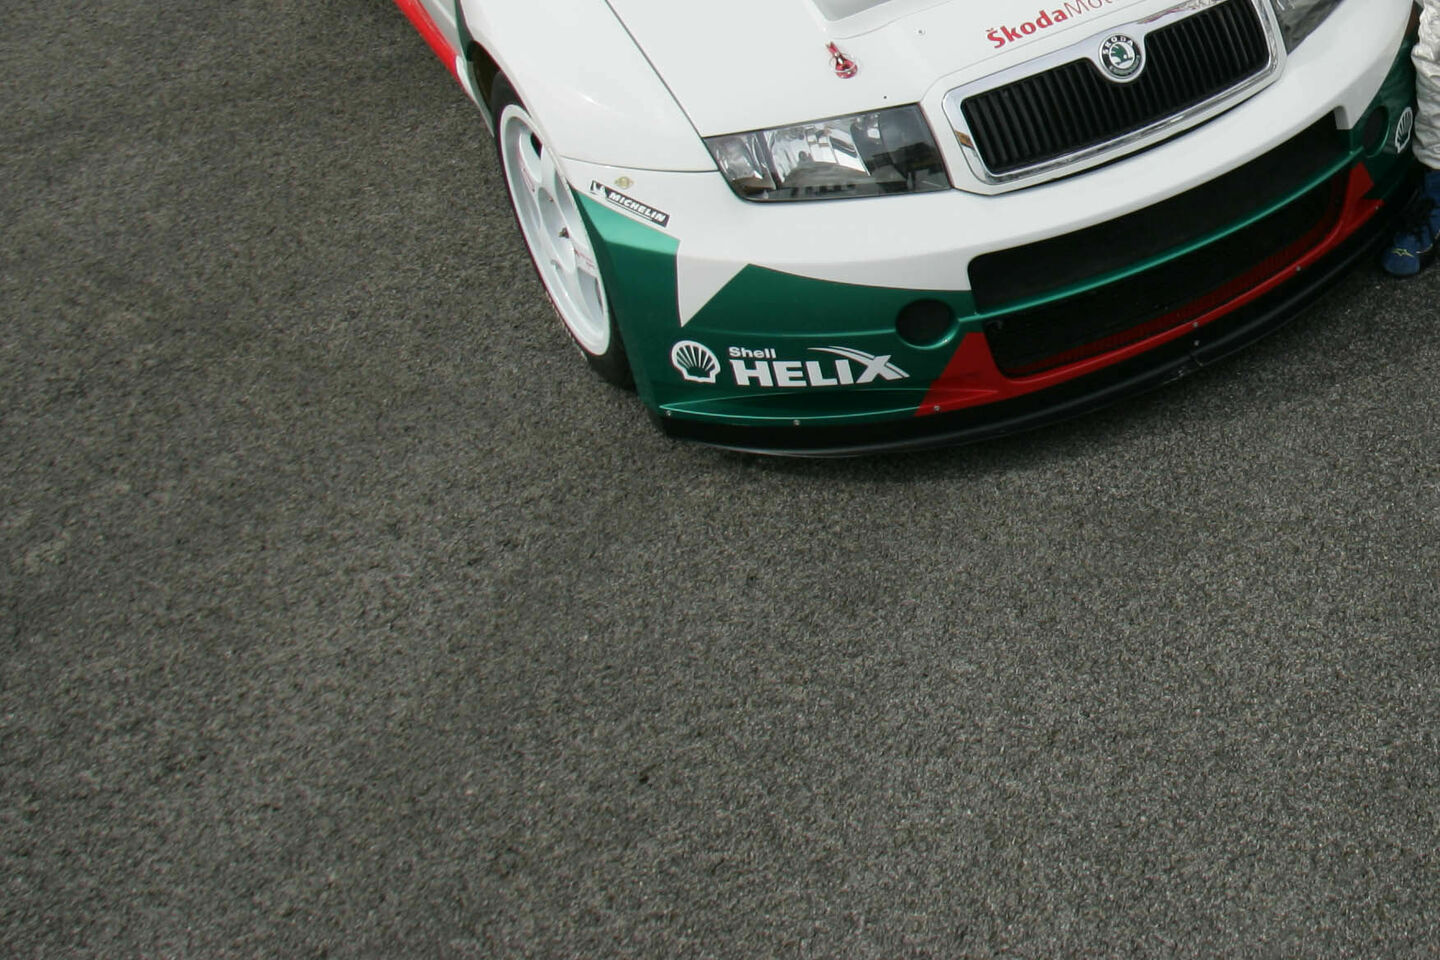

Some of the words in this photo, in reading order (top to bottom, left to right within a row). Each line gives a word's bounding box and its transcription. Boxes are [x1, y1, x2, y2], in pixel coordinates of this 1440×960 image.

[608, 191, 668, 224] MICHELIN
[728, 345, 777, 360] Shell
[728, 347, 910, 388] HELIX
